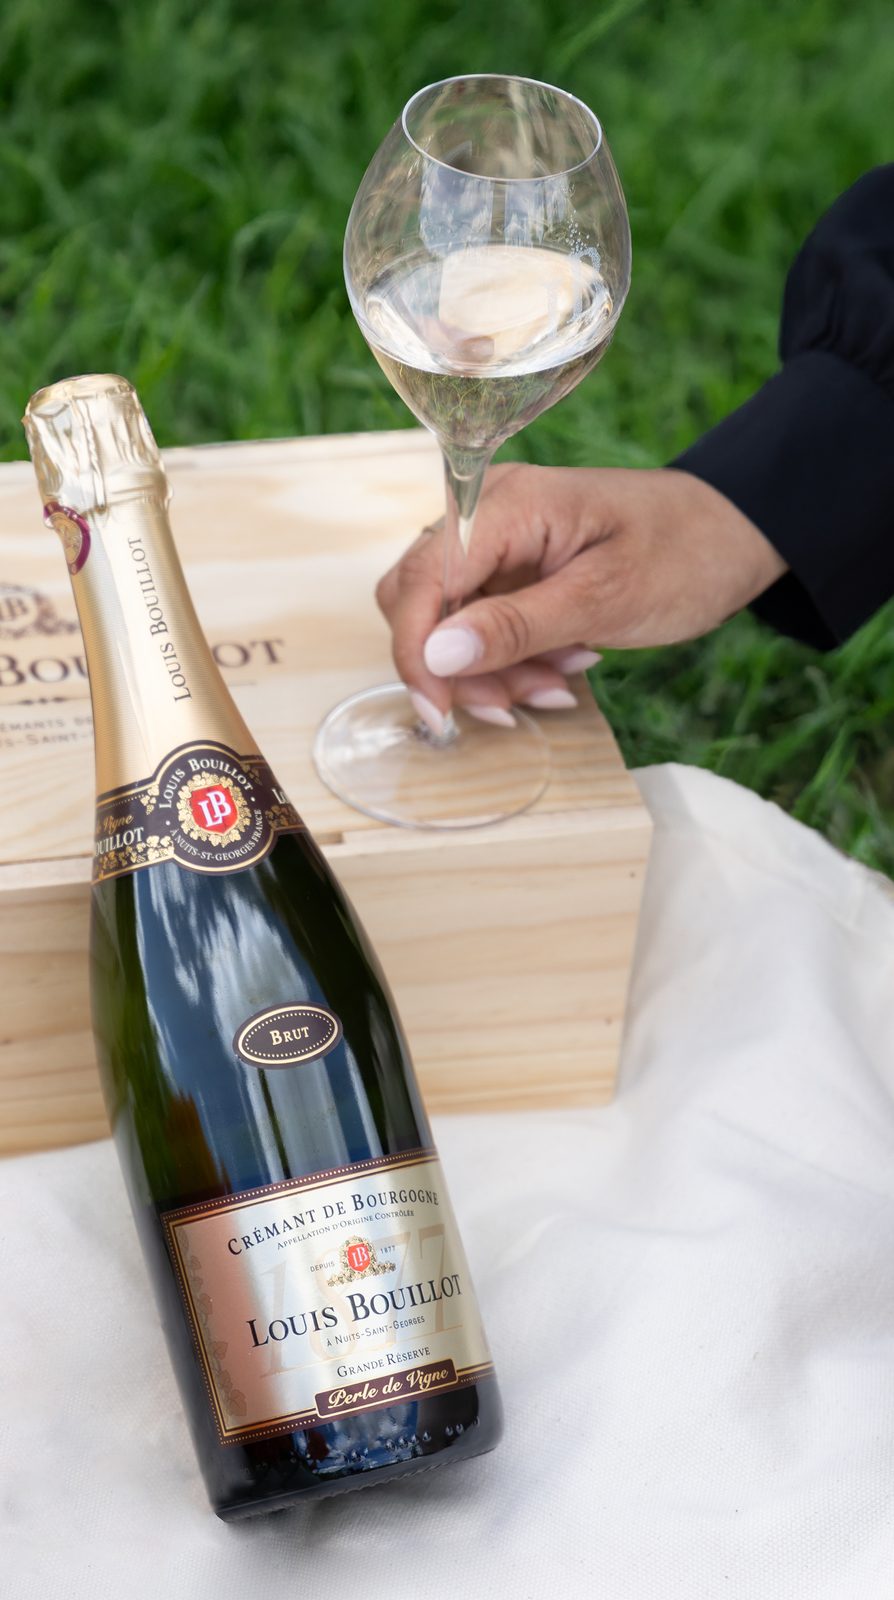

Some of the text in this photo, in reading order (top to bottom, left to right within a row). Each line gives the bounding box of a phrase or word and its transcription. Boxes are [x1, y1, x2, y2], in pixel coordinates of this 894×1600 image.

[128, 538, 192, 702] LOUIS BOUILLOT
[159, 758, 254, 808] LOUIS BOUILLOT
[198, 790, 231, 827] LB
[95, 826, 144, 856] OUILLOT
[174, 834, 256, 861] NUITS-ST-GEORGES
[252, 809, 263, 844] FRANCE
[269, 1026, 310, 1046] BRUT
[227, 1189, 439, 1256] CRÉMANT DE BOURGOGNE
[277, 1224, 331, 1251] APPELLATION
[351, 1246, 369, 1268] LB
[380, 1245, 396, 1255] 1877
[309, 1260, 335, 1273] DEPUIS
[246, 1274, 462, 1348] LOUIS BOUILLOT
[334, 1315, 426, 1346] NUITS-SAINT-GEORGES
[336, 1346, 431, 1378] GRANDE RÉSERVE
[327, 1368, 449, 1409] Perle de Vigne
